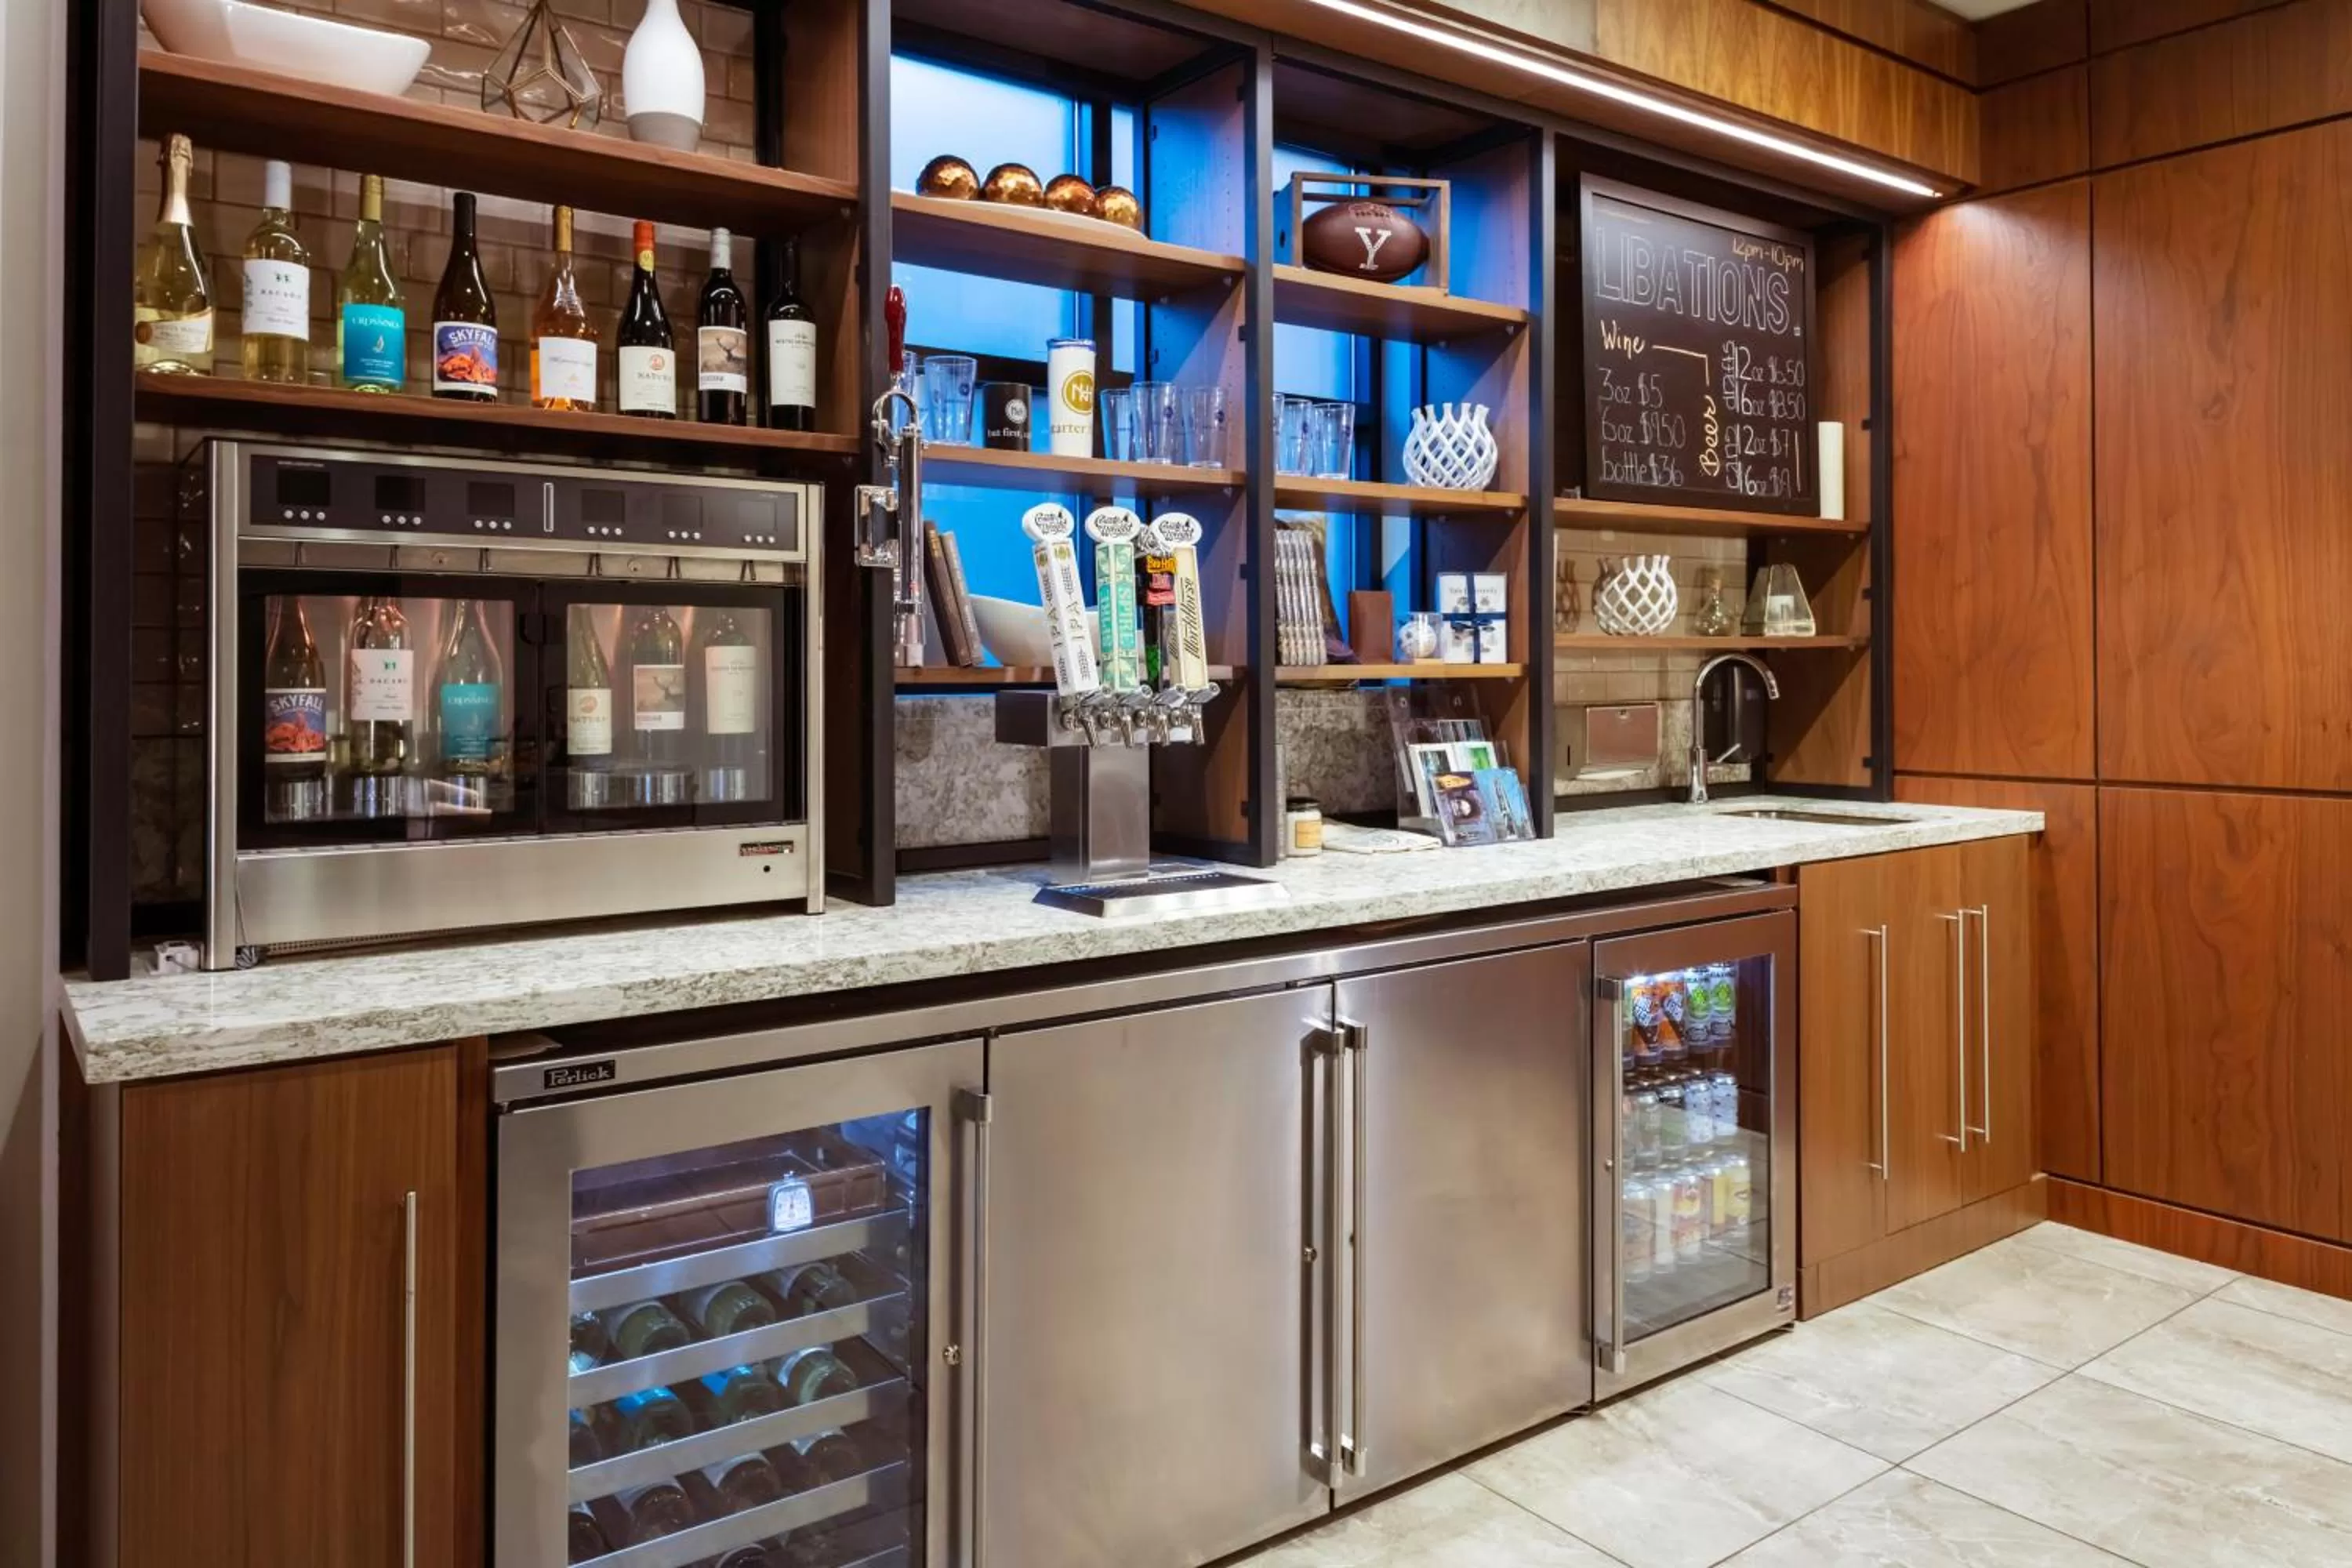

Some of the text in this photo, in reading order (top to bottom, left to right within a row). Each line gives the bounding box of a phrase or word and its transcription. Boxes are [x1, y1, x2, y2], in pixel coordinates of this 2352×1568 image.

[1354, 227, 1392, 270] Y
[1600, 320, 1646, 360] Wine
[1597, 367, 1632, 405] 3oz
[1699, 394, 1721, 477] Beer
[1599, 445, 1647, 483] bottle
[550, 1067, 612, 1086] Perlick
